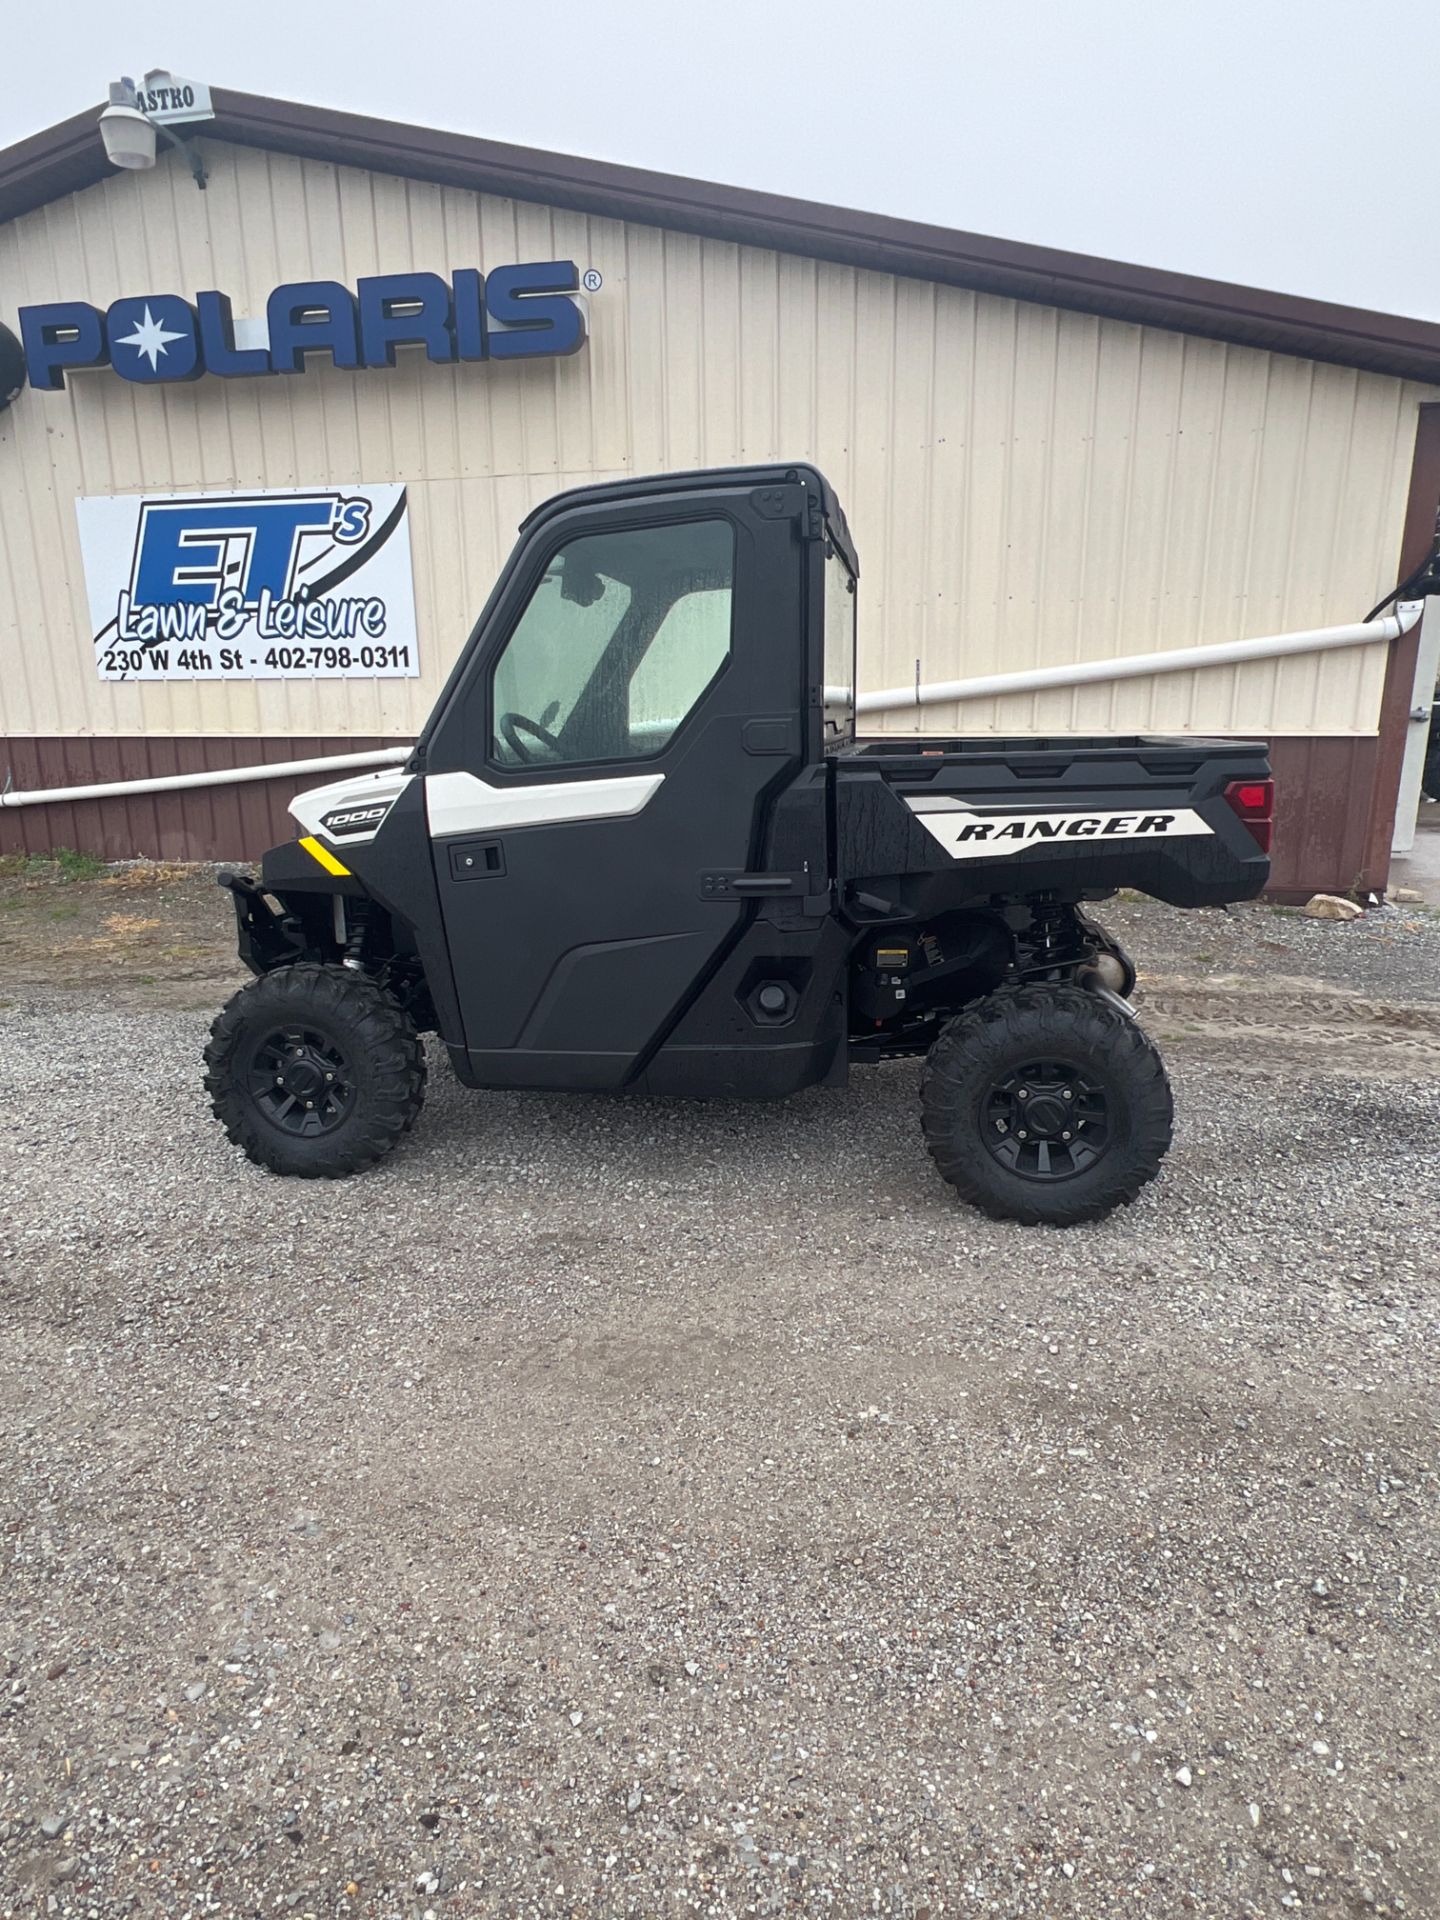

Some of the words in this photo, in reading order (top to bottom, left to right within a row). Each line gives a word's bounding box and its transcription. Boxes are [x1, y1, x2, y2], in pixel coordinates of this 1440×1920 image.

[18, 260, 588, 391] POLARIS
[118, 589, 211, 641] Lawn
[216, 586, 249, 642] &
[257, 583, 387, 639] Leisure
[104, 649, 144, 671] 230
[150, 650, 169, 670] W
[177, 649, 213, 671] 4th
[219, 648, 244, 671] St
[264, 645, 410, 670] 402-798-0311
[326, 807, 387, 827] 1000
[955, 814, 1176, 842] RANGER
